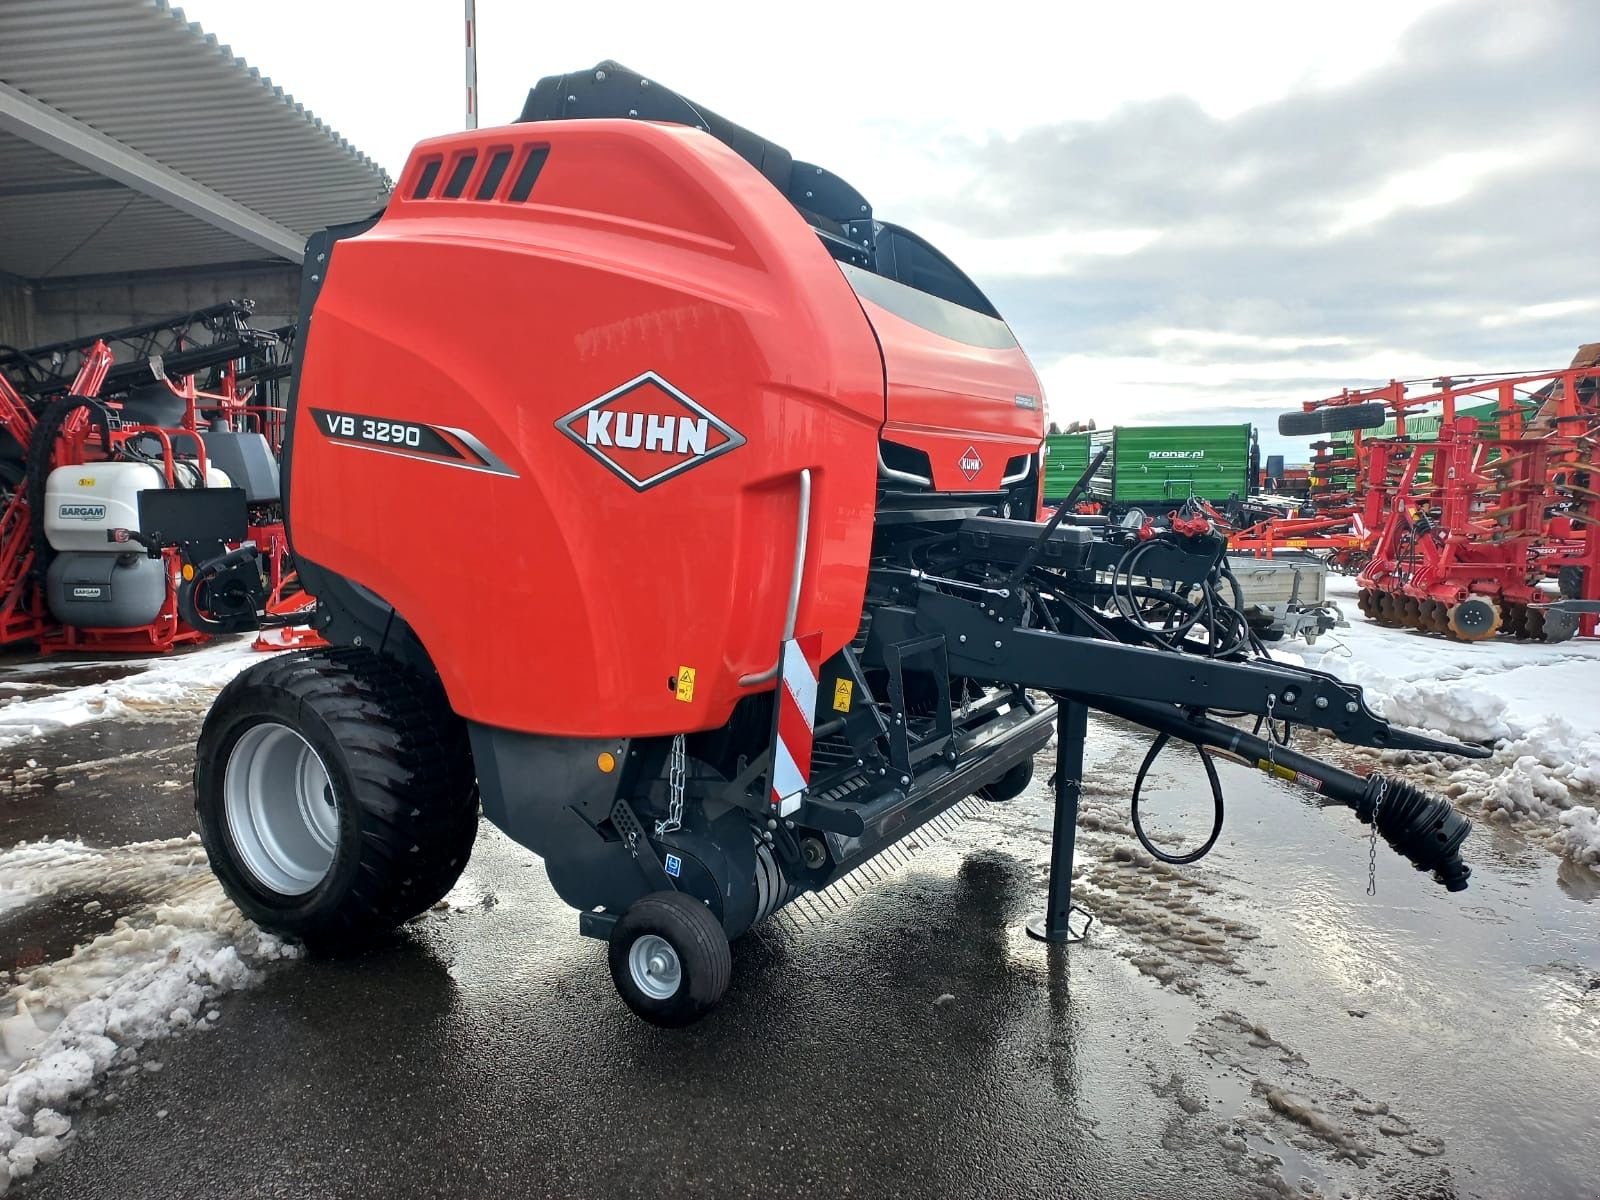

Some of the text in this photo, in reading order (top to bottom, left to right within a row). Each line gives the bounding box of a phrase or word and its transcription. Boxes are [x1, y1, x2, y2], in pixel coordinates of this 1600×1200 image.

[326, 414, 420, 447] VB 3290
[587, 409, 708, 455] KUHN
[1149, 449, 1204, 459] pronar.pl
[962, 457, 980, 470] KUHN
[61, 507, 104, 516] BARGAM
